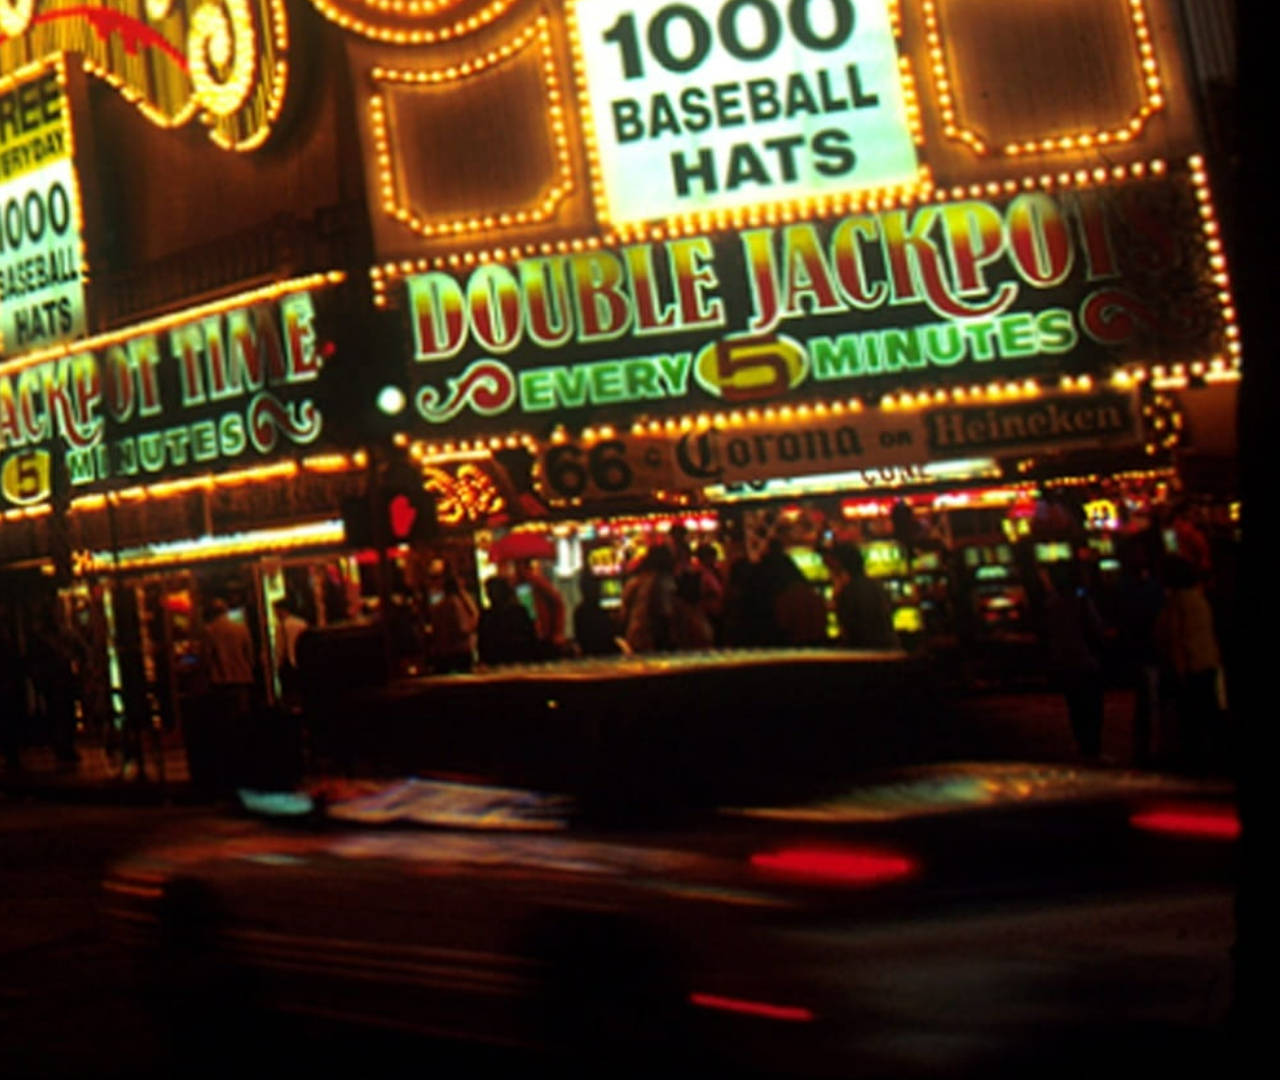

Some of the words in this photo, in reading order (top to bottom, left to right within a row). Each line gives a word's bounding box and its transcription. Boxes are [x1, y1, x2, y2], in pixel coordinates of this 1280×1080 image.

[610, 63, 880, 145] BASEBALL
[670, 127, 858, 198] HATS
[13, 296, 74, 346] HATS
[405, 235, 726, 362] DOUBLE
[519, 352, 694, 413] EVERY
[717, 336, 794, 400] 5
[806, 307, 1079, 381] MINUTES
[16, 453, 40, 500] 5
[675, 424, 865, 479] Corona
[927, 400, 1123, 446] Heineken
